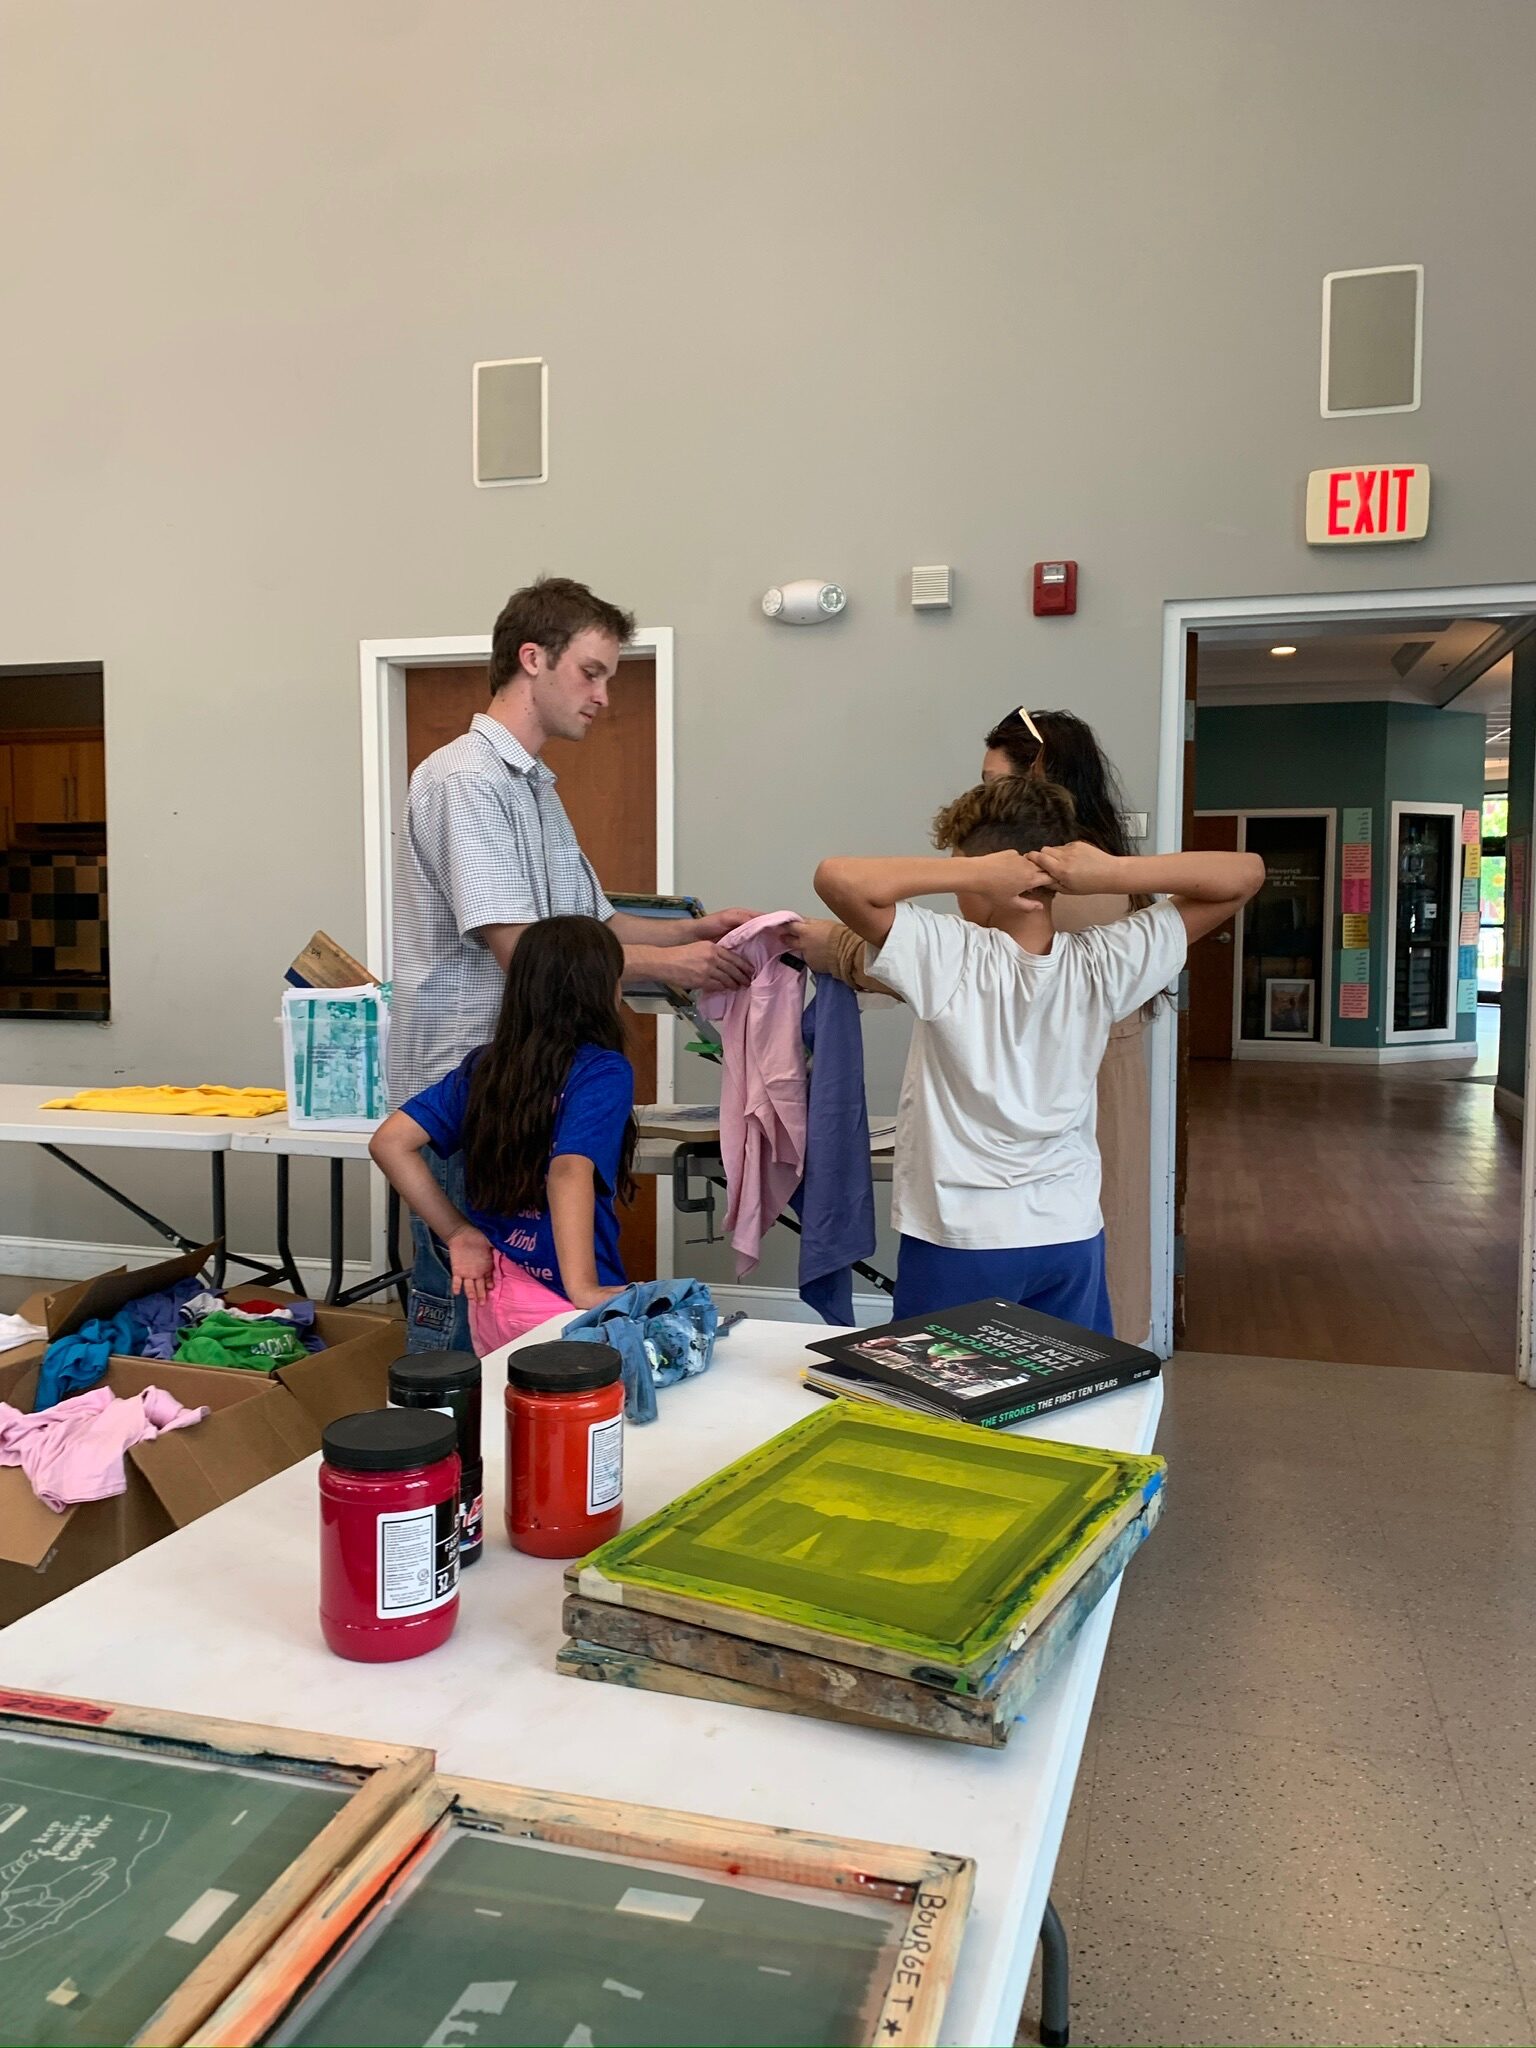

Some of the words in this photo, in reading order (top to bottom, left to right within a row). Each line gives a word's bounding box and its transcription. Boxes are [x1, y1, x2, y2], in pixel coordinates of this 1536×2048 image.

[1328, 468, 1415, 536] EXIT
[504, 1228, 538, 1252] Kind
[924, 1324, 1014, 1359] STROKES
[969, 1333, 1029, 1354] FIRST
[977, 1325, 1043, 1350] YEARS
[1010, 1357, 1054, 1376] THE
[1026, 1352, 1070, 1372] THE
[1042, 1349, 1085, 1367] TEN
[980, 1416, 998, 1428] THE
[998, 1404, 1036, 1423] STROKES
[1037, 1398, 1053, 1411] THE
[1054, 1391, 1077, 1407] FIRST
[1077, 1385, 1093, 1398] TEN
[1094, 1378, 1119, 1391] YEARS
[54, 1814, 114, 1862] together
